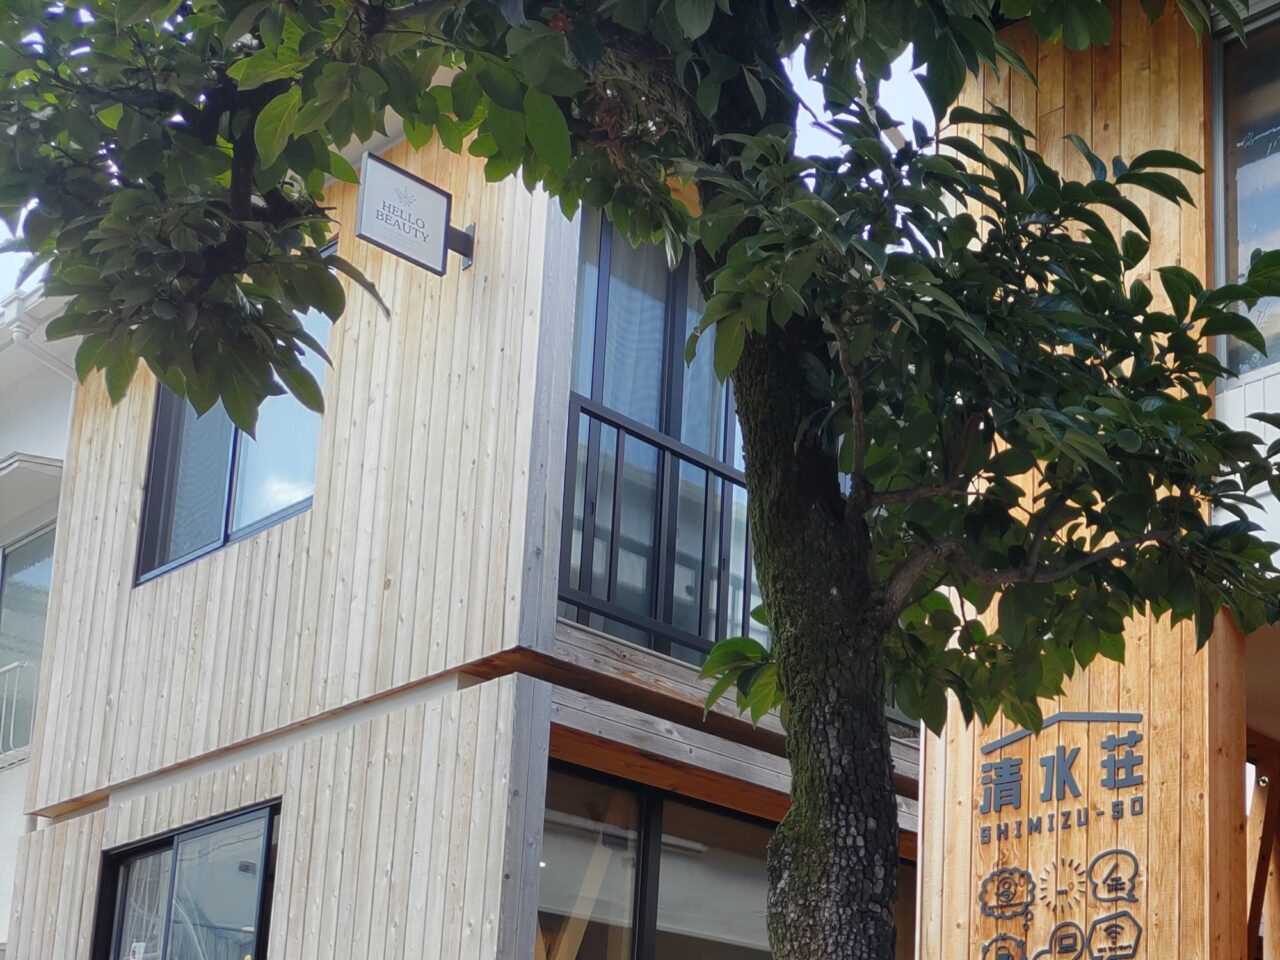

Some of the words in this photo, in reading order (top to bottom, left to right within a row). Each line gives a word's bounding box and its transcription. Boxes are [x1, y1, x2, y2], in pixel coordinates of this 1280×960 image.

[375, 209, 429, 242] BEAUTY
[382, 200, 425, 229] HELLO
[979, 730, 1144, 815] 清水荘
[979, 795, 1144, 845] SHIMIZU-SO
